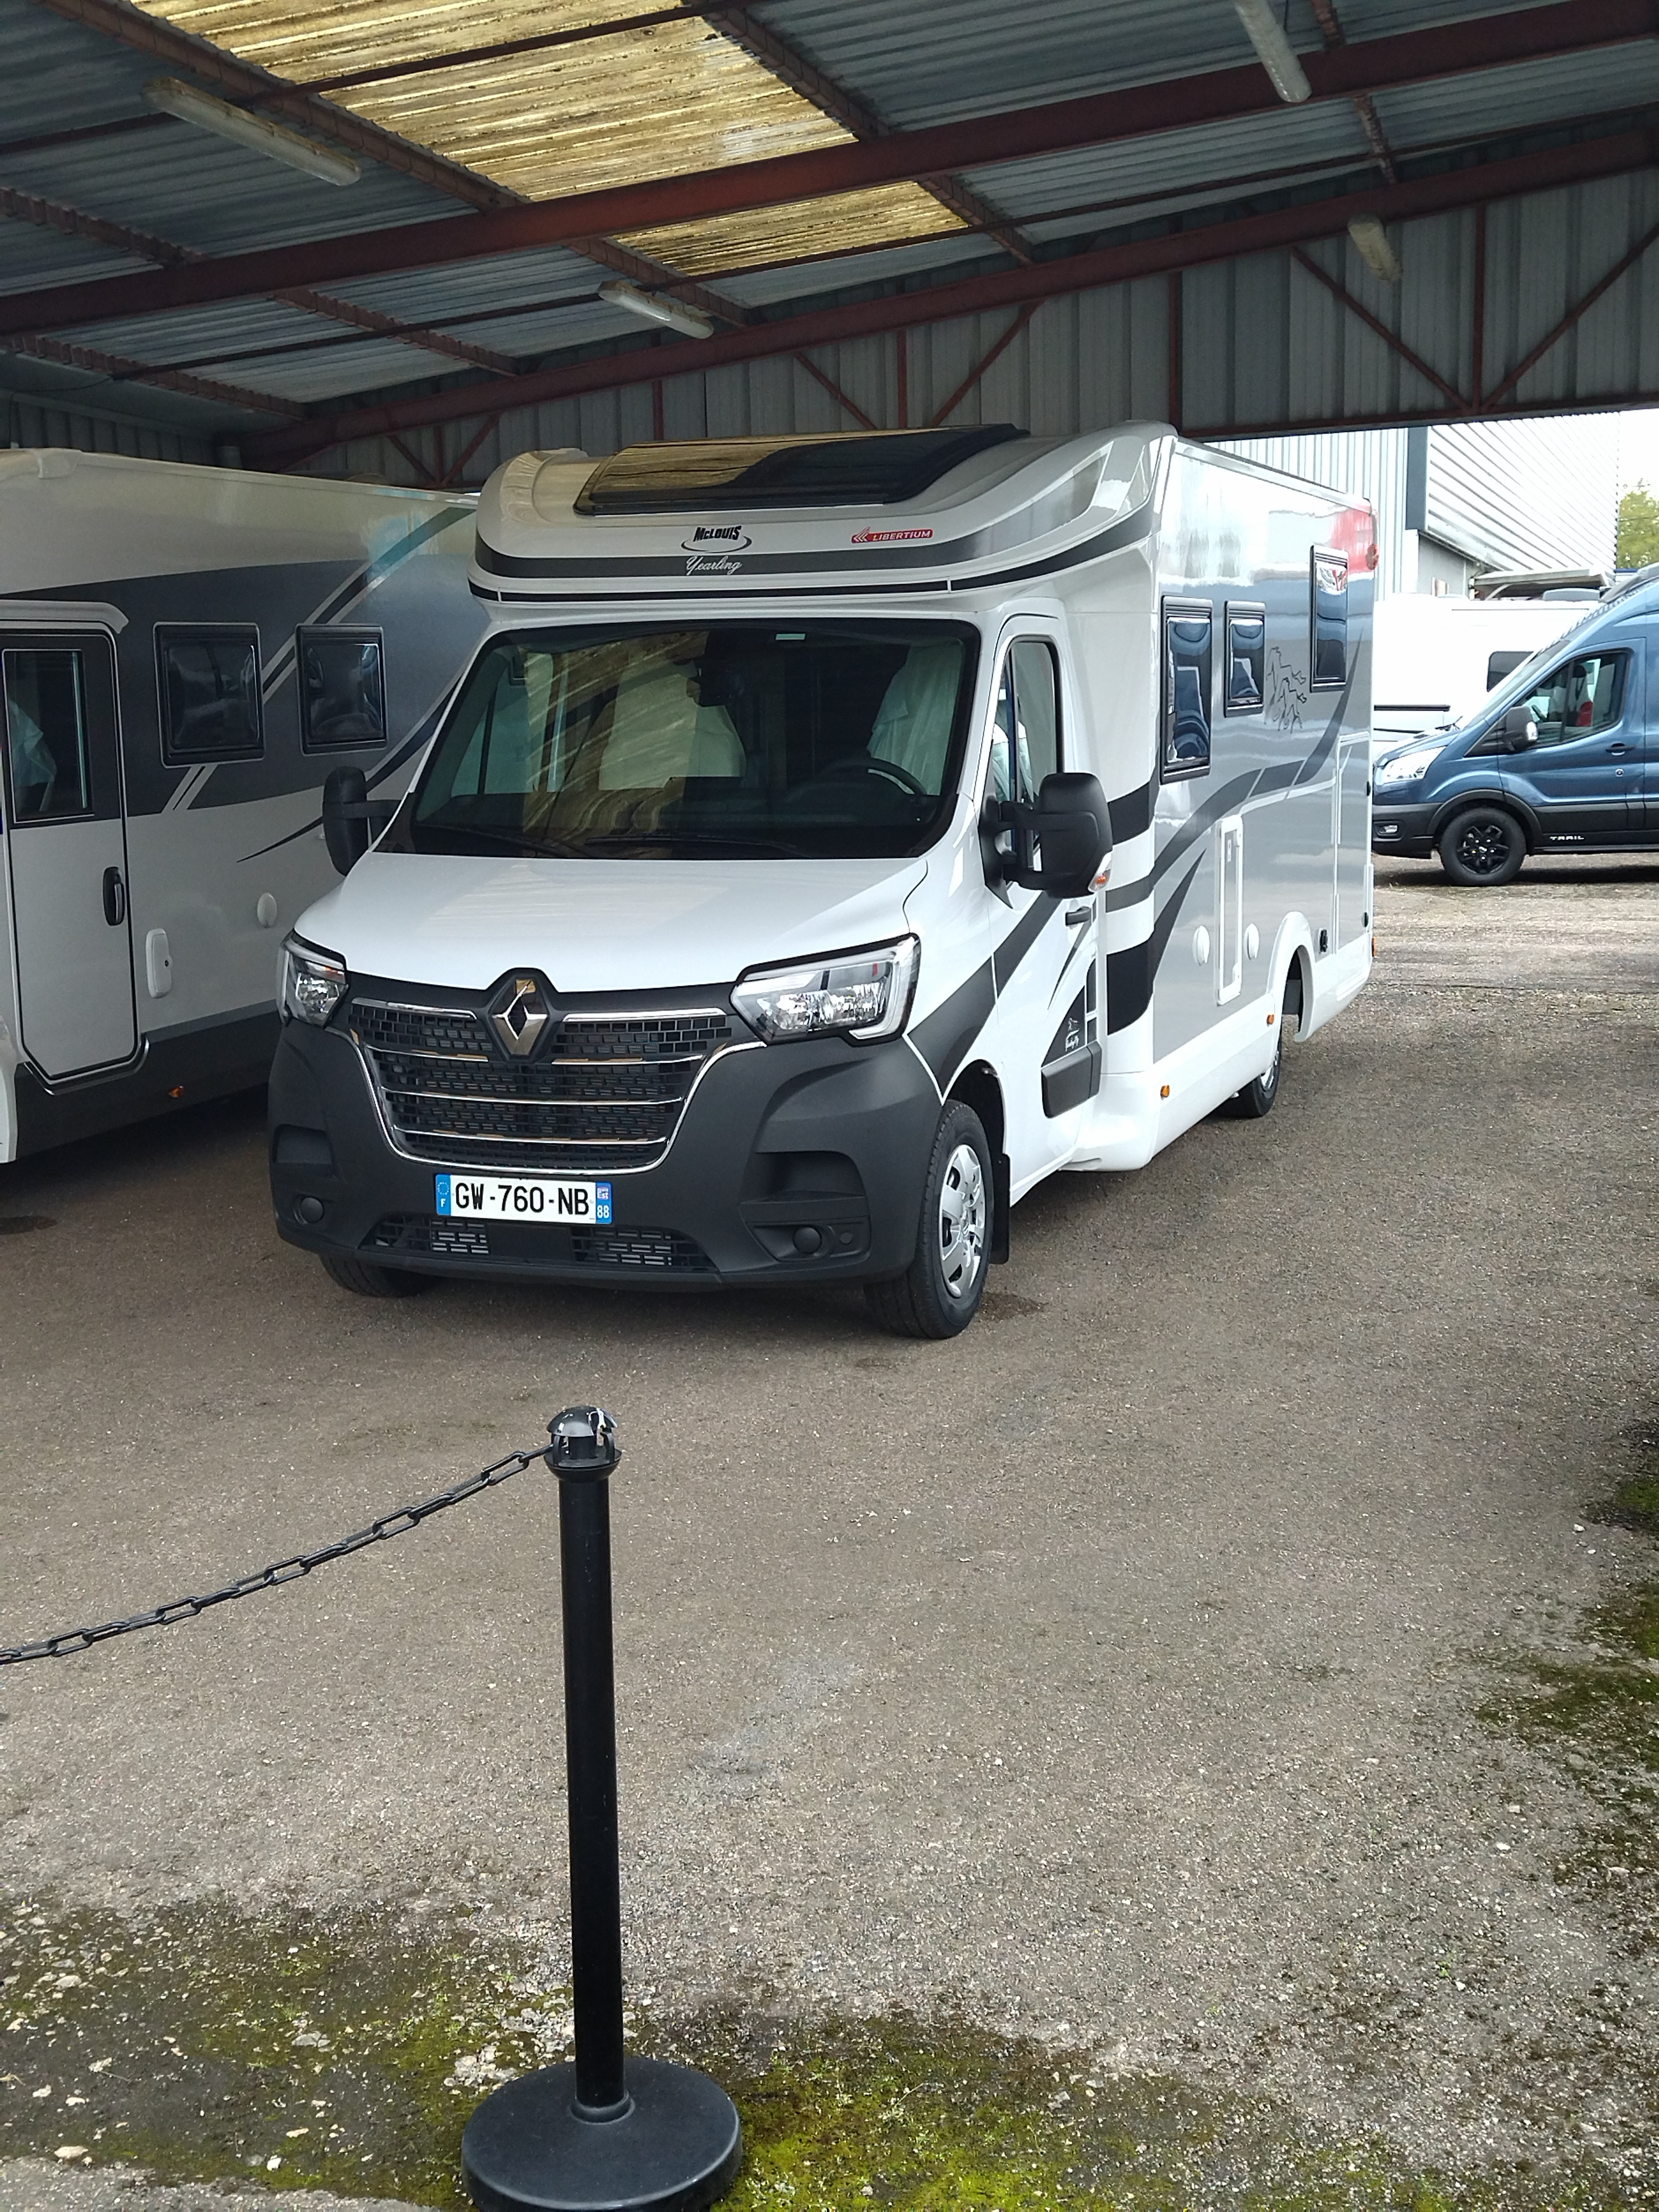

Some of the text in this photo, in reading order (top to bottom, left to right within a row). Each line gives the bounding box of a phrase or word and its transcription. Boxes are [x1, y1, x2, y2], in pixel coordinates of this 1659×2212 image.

[873, 530, 931, 541] LIBERTIUM
[686, 555, 742, 576] Yearling
[441, 1198, 446, 1208] F
[455, 1182, 589, 1215] GW-760-NB
[597, 1205, 609, 1219] 88
